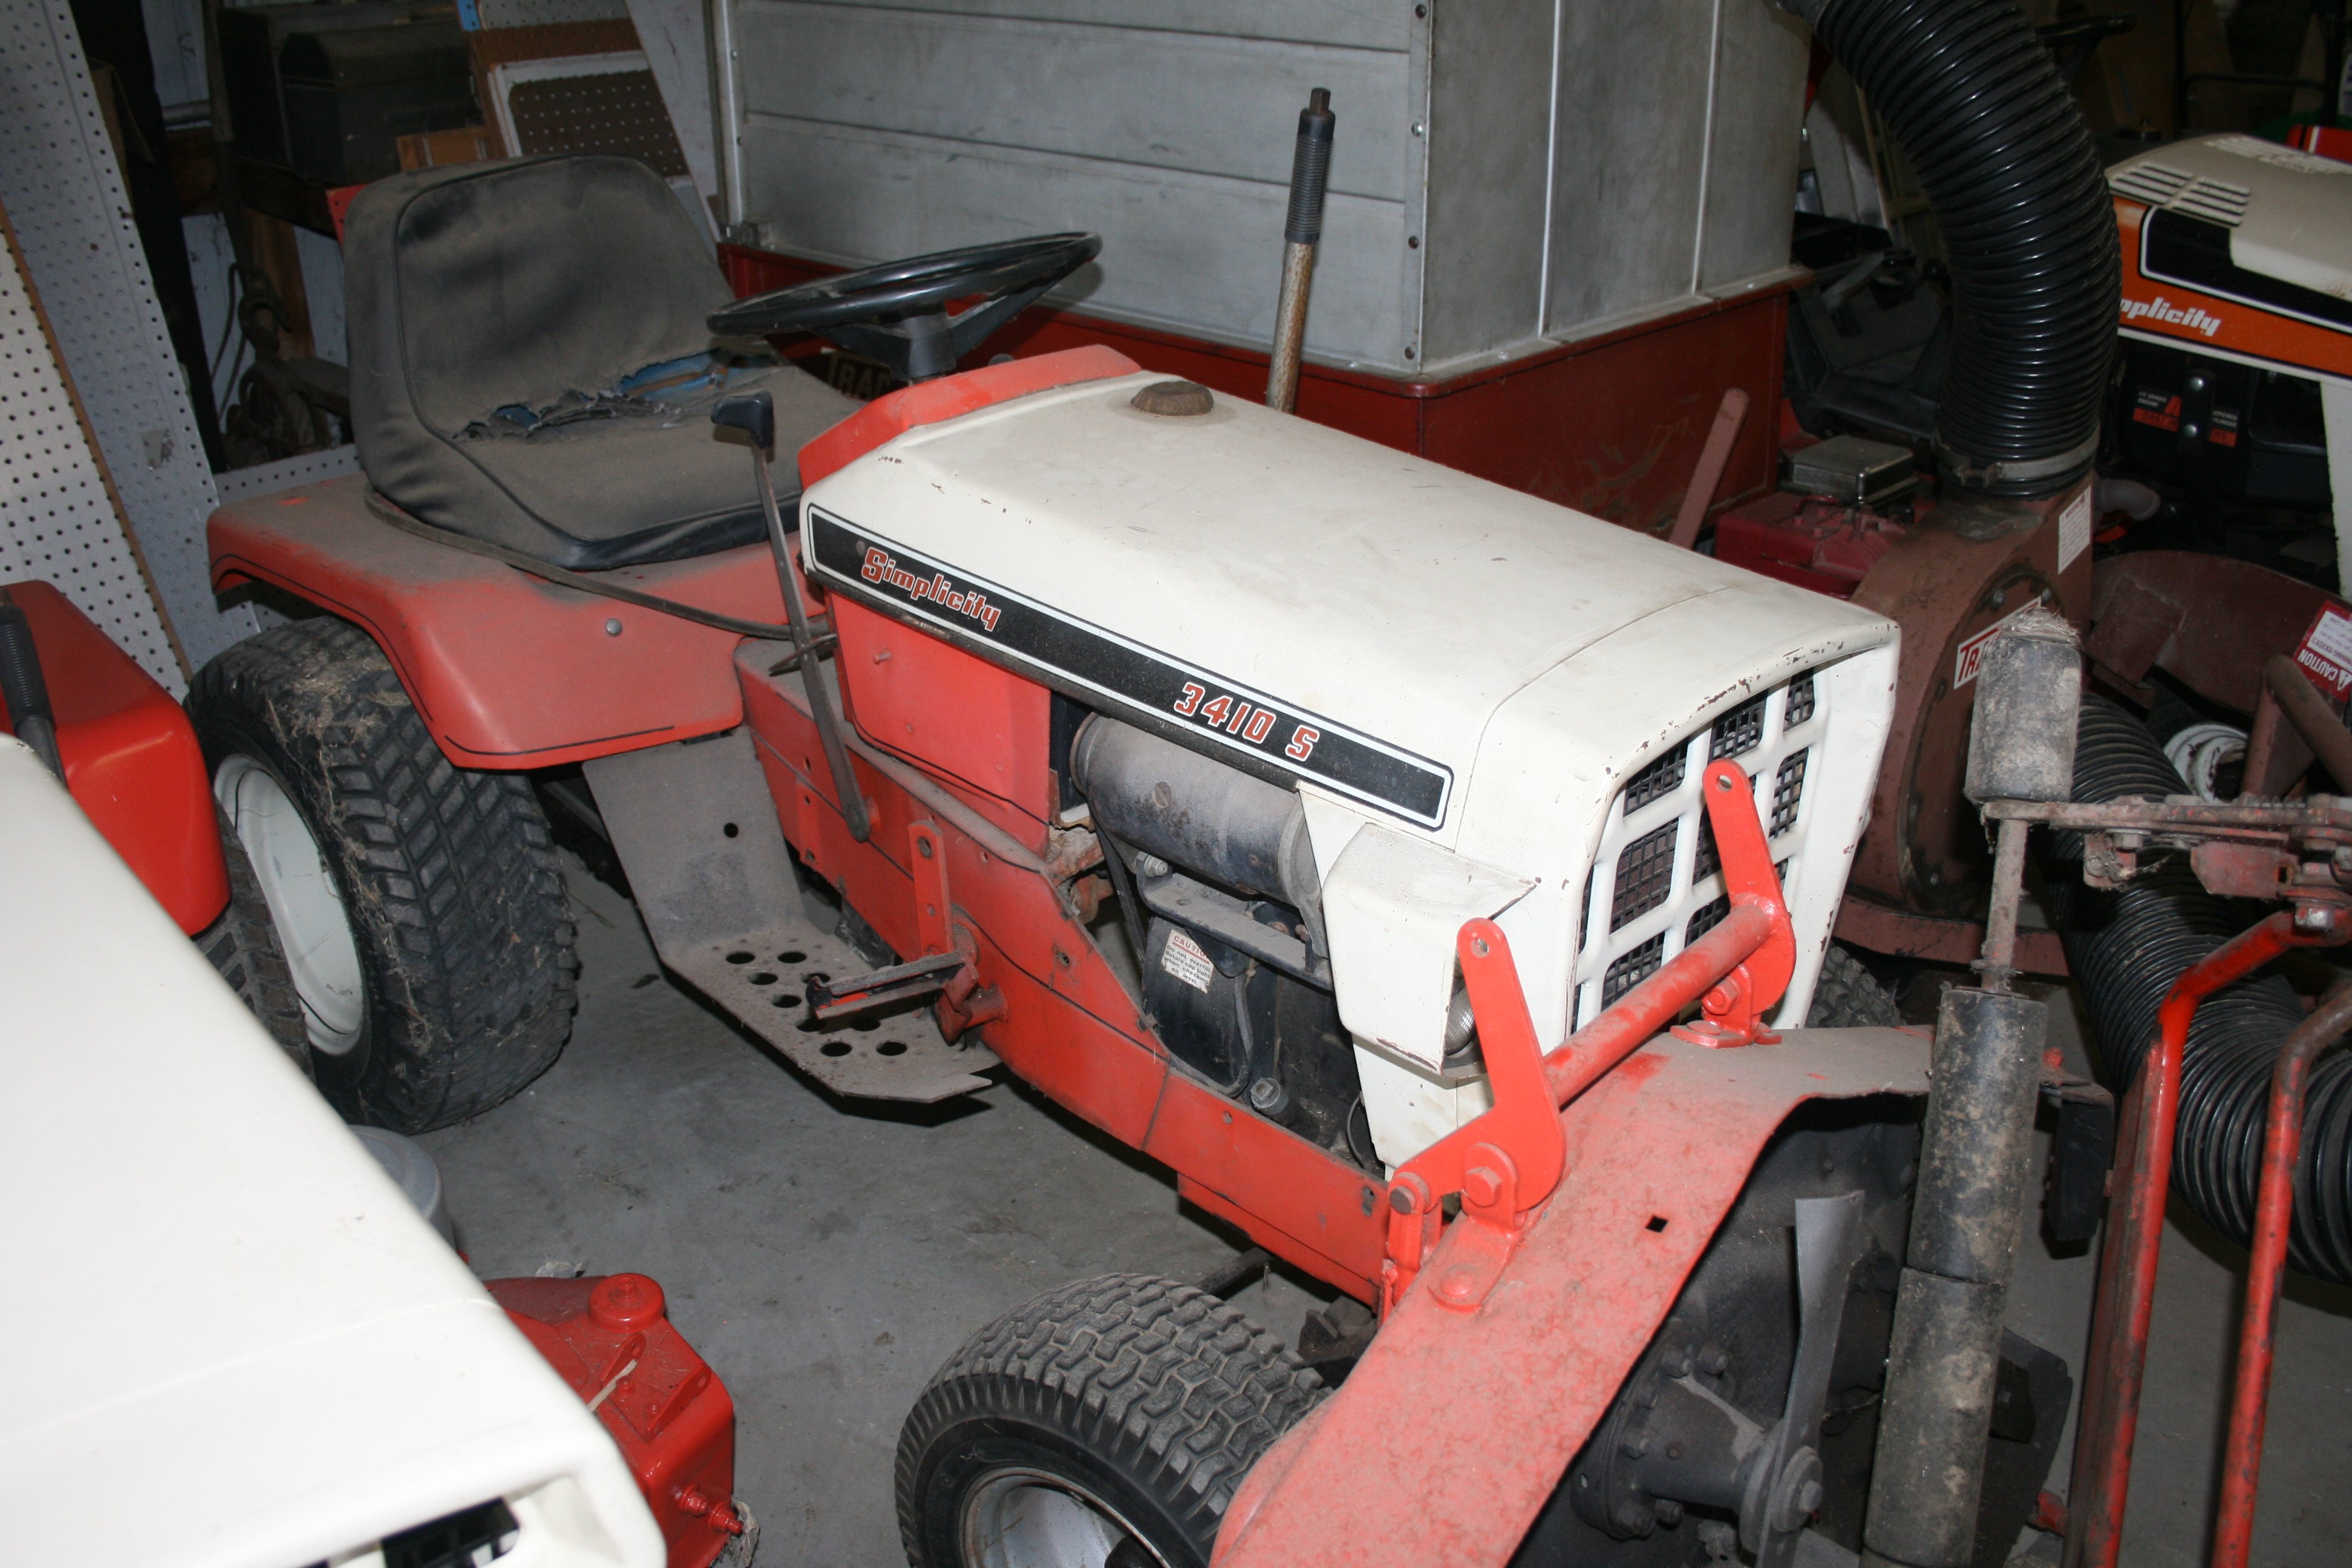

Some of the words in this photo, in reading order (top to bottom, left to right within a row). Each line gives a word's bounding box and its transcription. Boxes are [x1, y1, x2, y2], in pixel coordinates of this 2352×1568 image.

[861, 547, 1001, 632] Simplicity
[2298, 649, 2339, 681] CAUTION
[1174, 682, 1276, 744] 3410
[1285, 725, 1320, 762] S
[1174, 935, 1205, 956] CAUTIO
[1177, 950, 1187, 959] not
[1164, 957, 1179, 967] when
[1183, 967, 1209, 985] checking
[1165, 950, 1184, 964] Rotate
[1185, 961, 1196, 970] cap
[1197, 968, 1210, 979] tight
